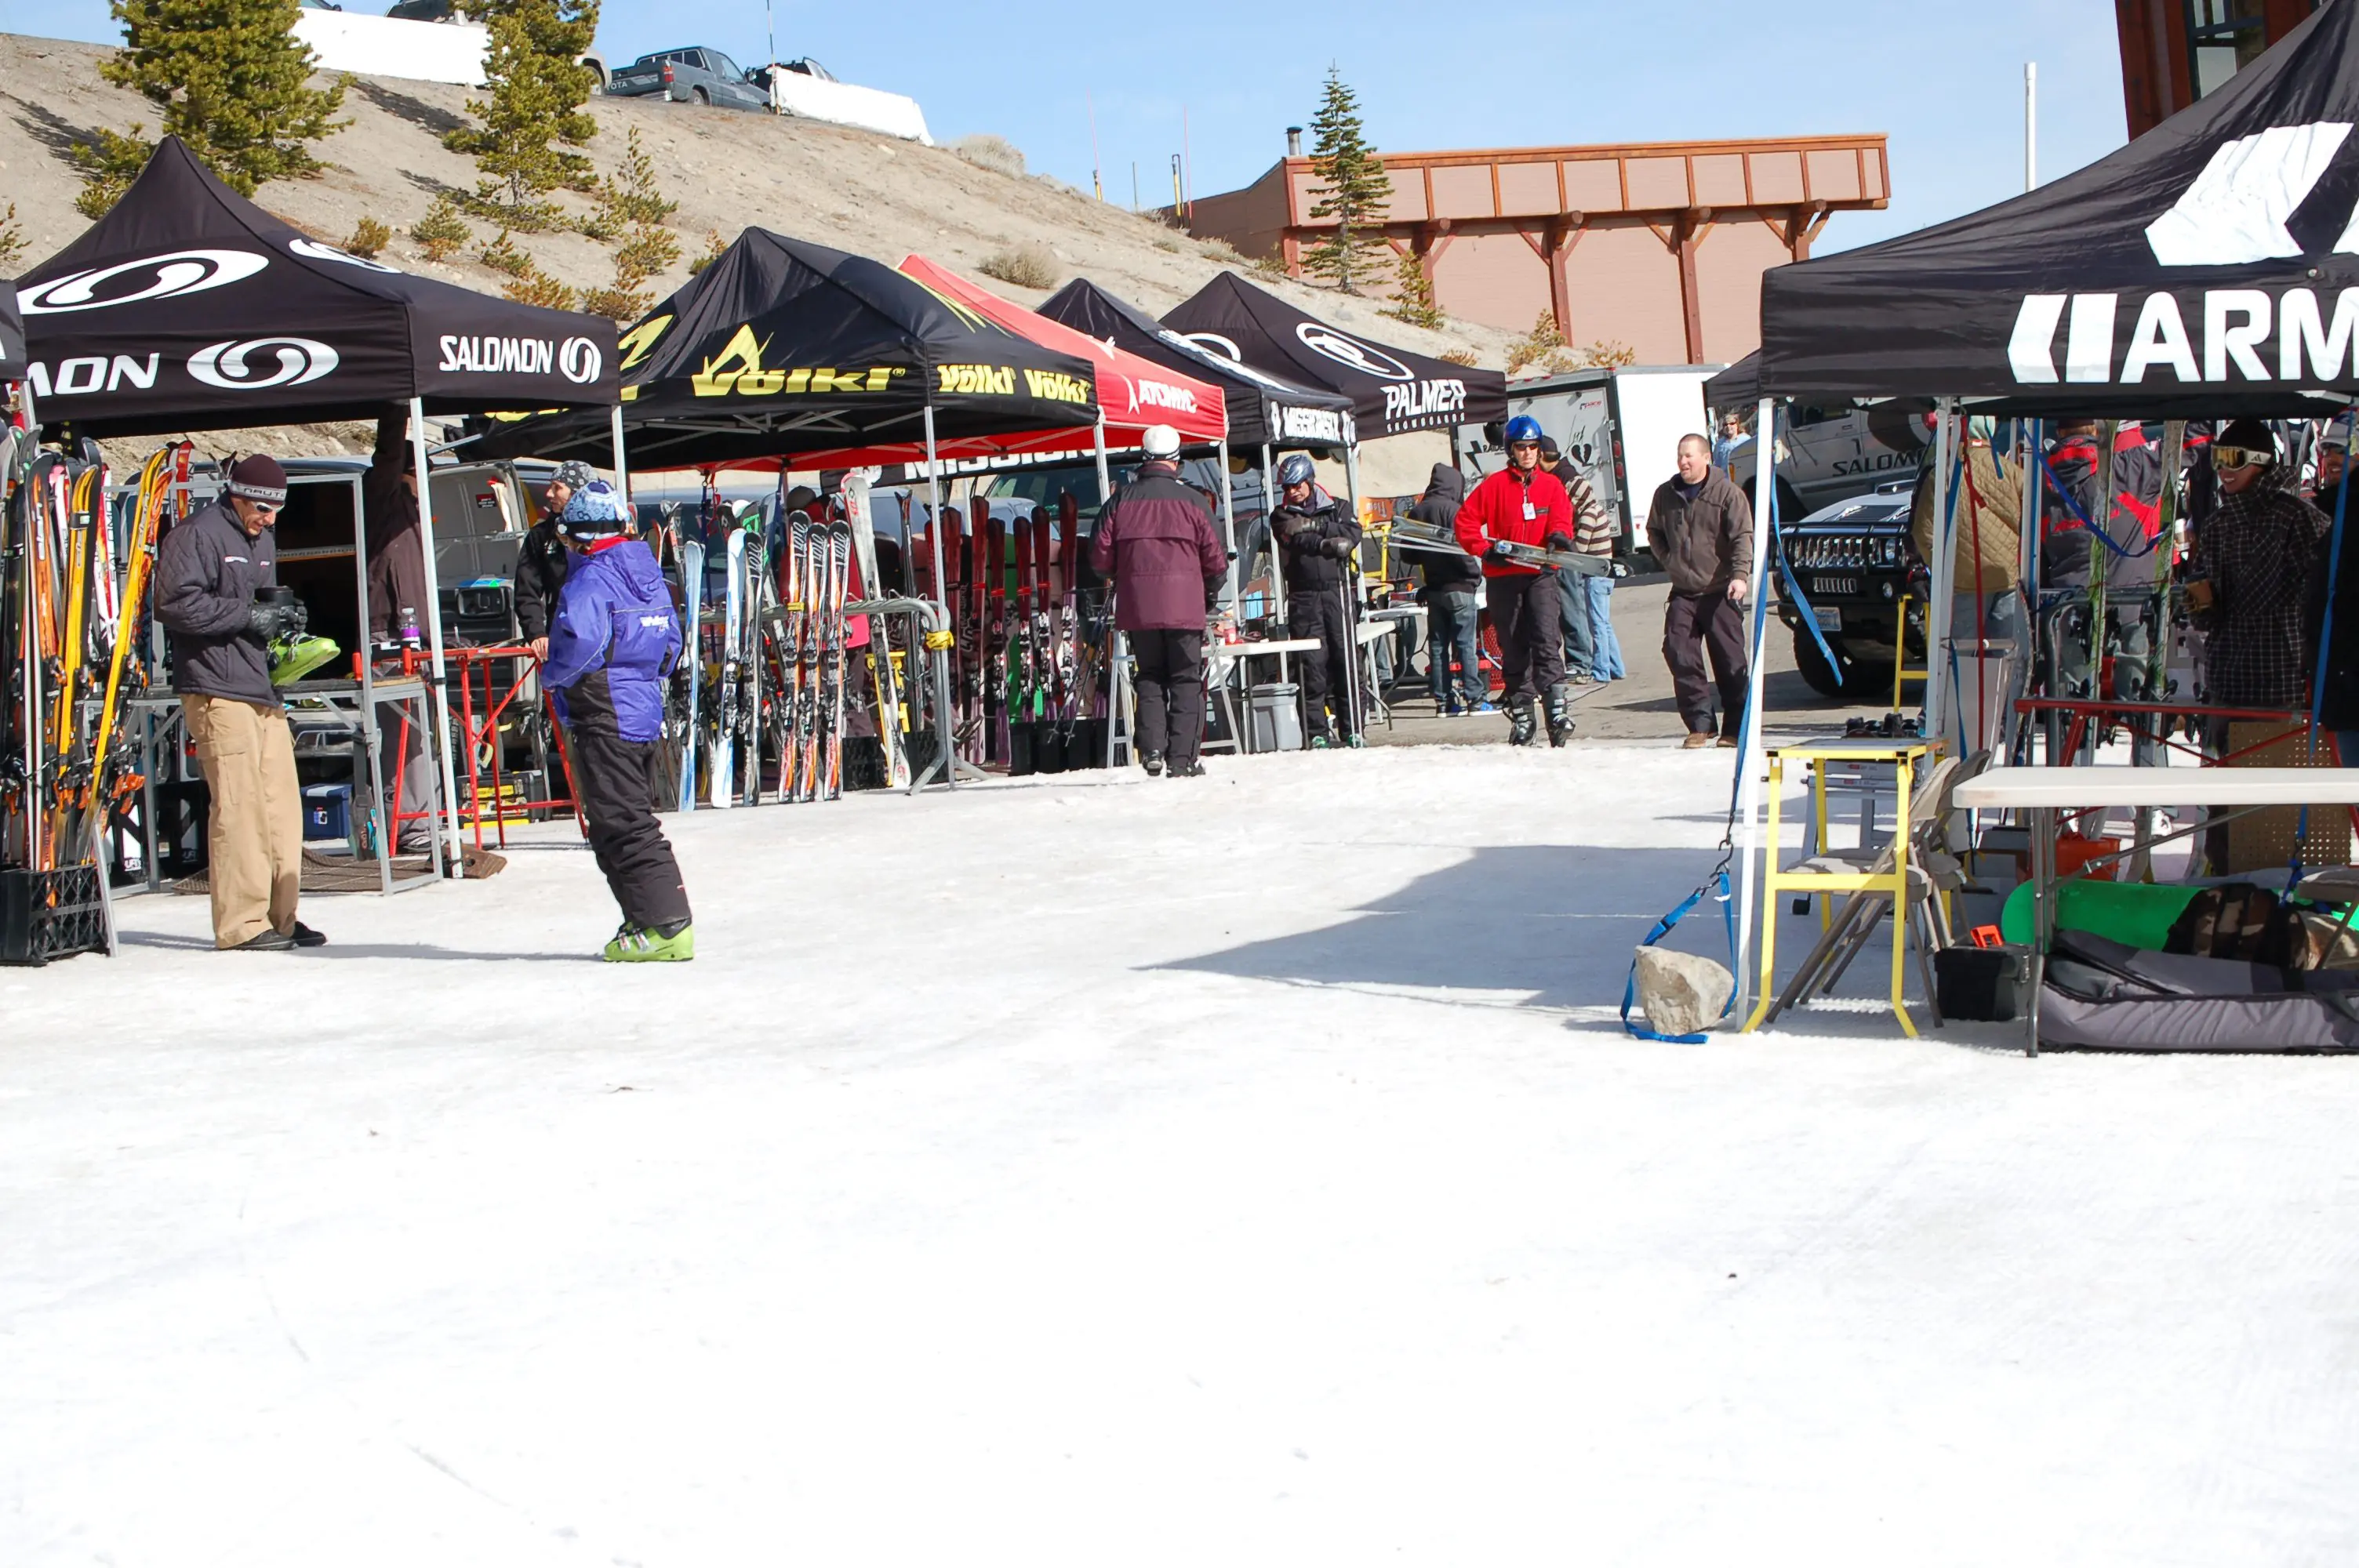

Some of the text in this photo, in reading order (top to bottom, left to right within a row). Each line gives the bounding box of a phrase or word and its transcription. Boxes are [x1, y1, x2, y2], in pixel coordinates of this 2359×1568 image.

[439, 335, 553, 374] SALOMON
[1138, 379, 1198, 413] ATOMIC
[1380, 379, 1467, 420] PALMER
